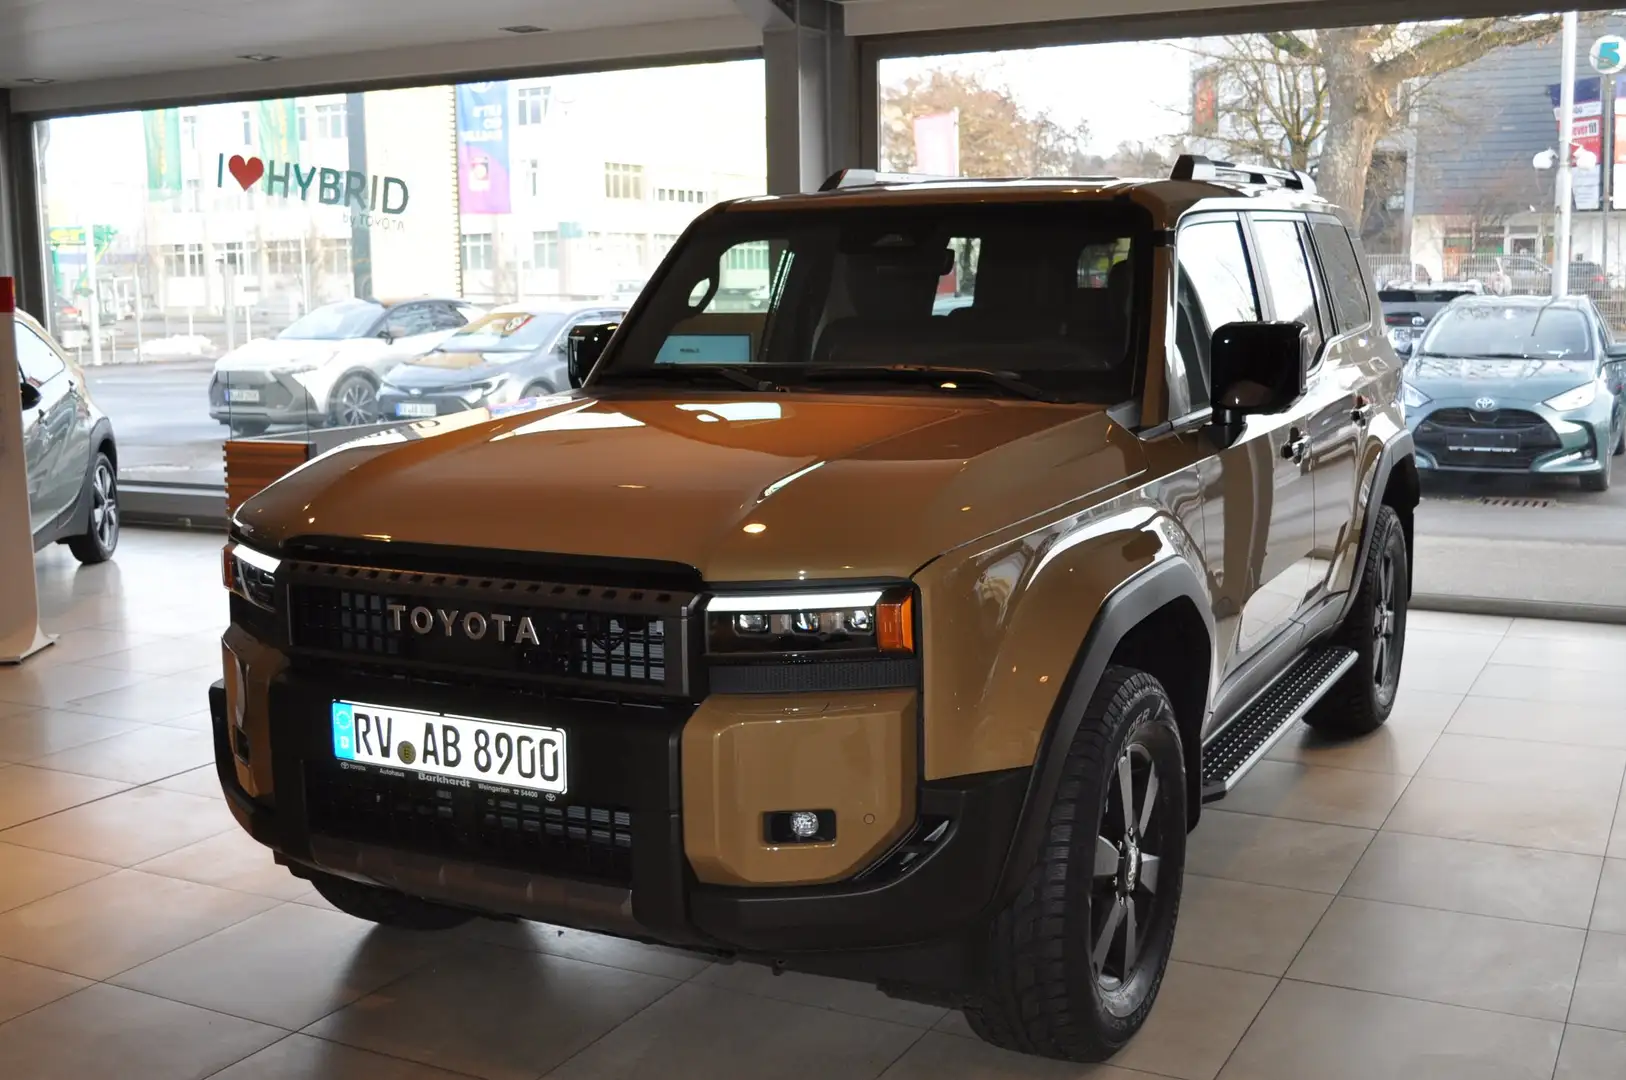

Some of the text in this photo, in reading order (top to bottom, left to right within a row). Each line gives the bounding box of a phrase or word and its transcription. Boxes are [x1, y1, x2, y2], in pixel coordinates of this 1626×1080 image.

[1598, 42, 1620, 70] 5
[267, 159, 410, 215] HYBRID
[343, 212, 405, 231] by TOYOTA
[387, 604, 540, 646] TOYOTA
[353, 712, 393, 759] RV
[422, 722, 462, 768] AB
[473, 728, 559, 782] 8900
[379, 767, 405, 778] Autohaus
[521, 789, 539, 799] 54400
